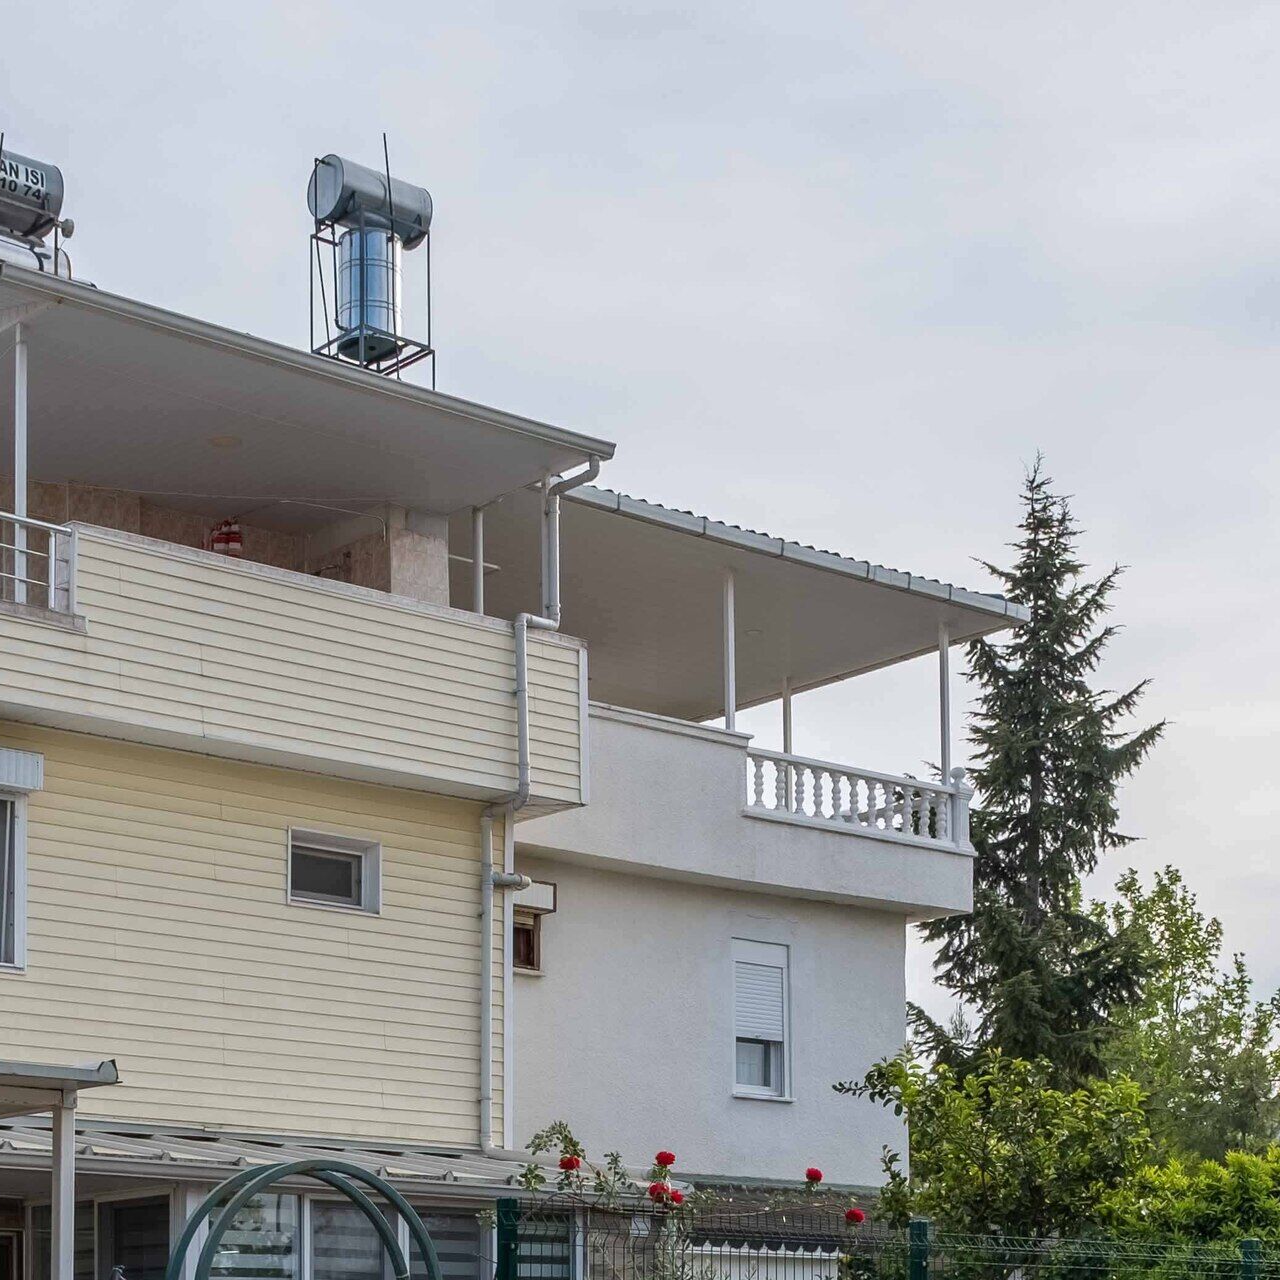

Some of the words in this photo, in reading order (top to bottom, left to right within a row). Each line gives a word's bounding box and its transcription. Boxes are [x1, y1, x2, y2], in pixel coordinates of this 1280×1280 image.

[0, 176, 17, 192] 10
[23, 184, 42, 200] 74
[25, 167, 45, 188] ISI
